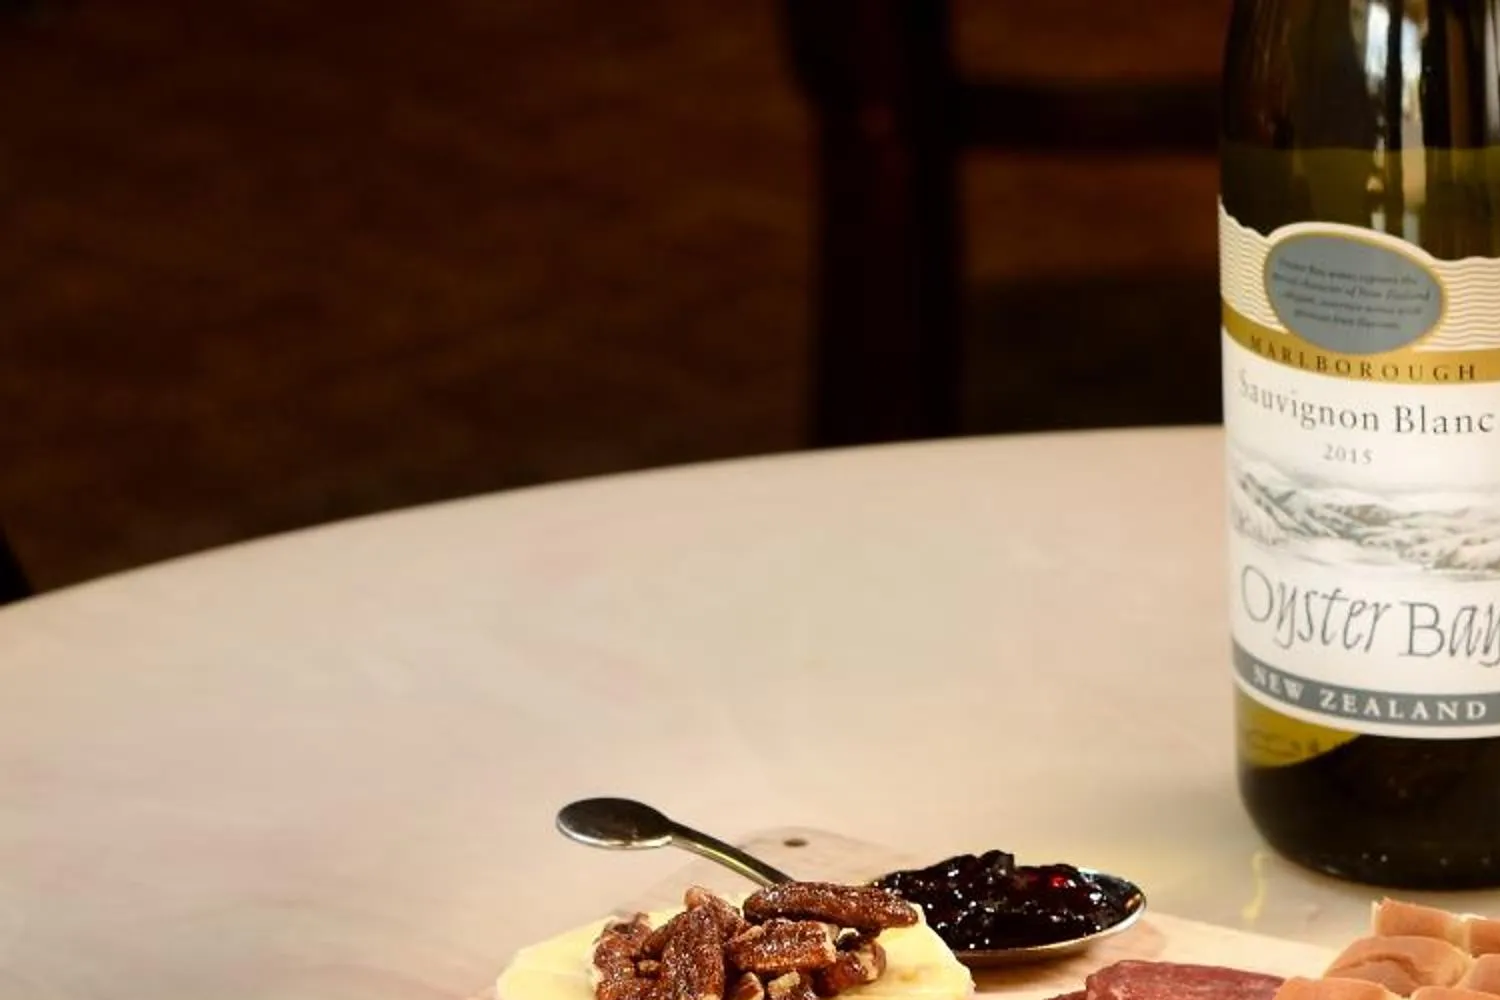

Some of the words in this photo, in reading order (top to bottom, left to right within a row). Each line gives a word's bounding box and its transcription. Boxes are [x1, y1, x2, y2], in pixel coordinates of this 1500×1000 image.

[1250, 335, 1477, 380] MARLBOROUGH
[1239, 368, 1380, 432] Sauvignon
[1394, 404, 1495, 434] Blanc
[1323, 443, 1373, 465] 2015
[1241, 564, 1392, 653] Oyster
[1253, 663, 1304, 700] NEW
[1319, 687, 1487, 720] ZEALAND
